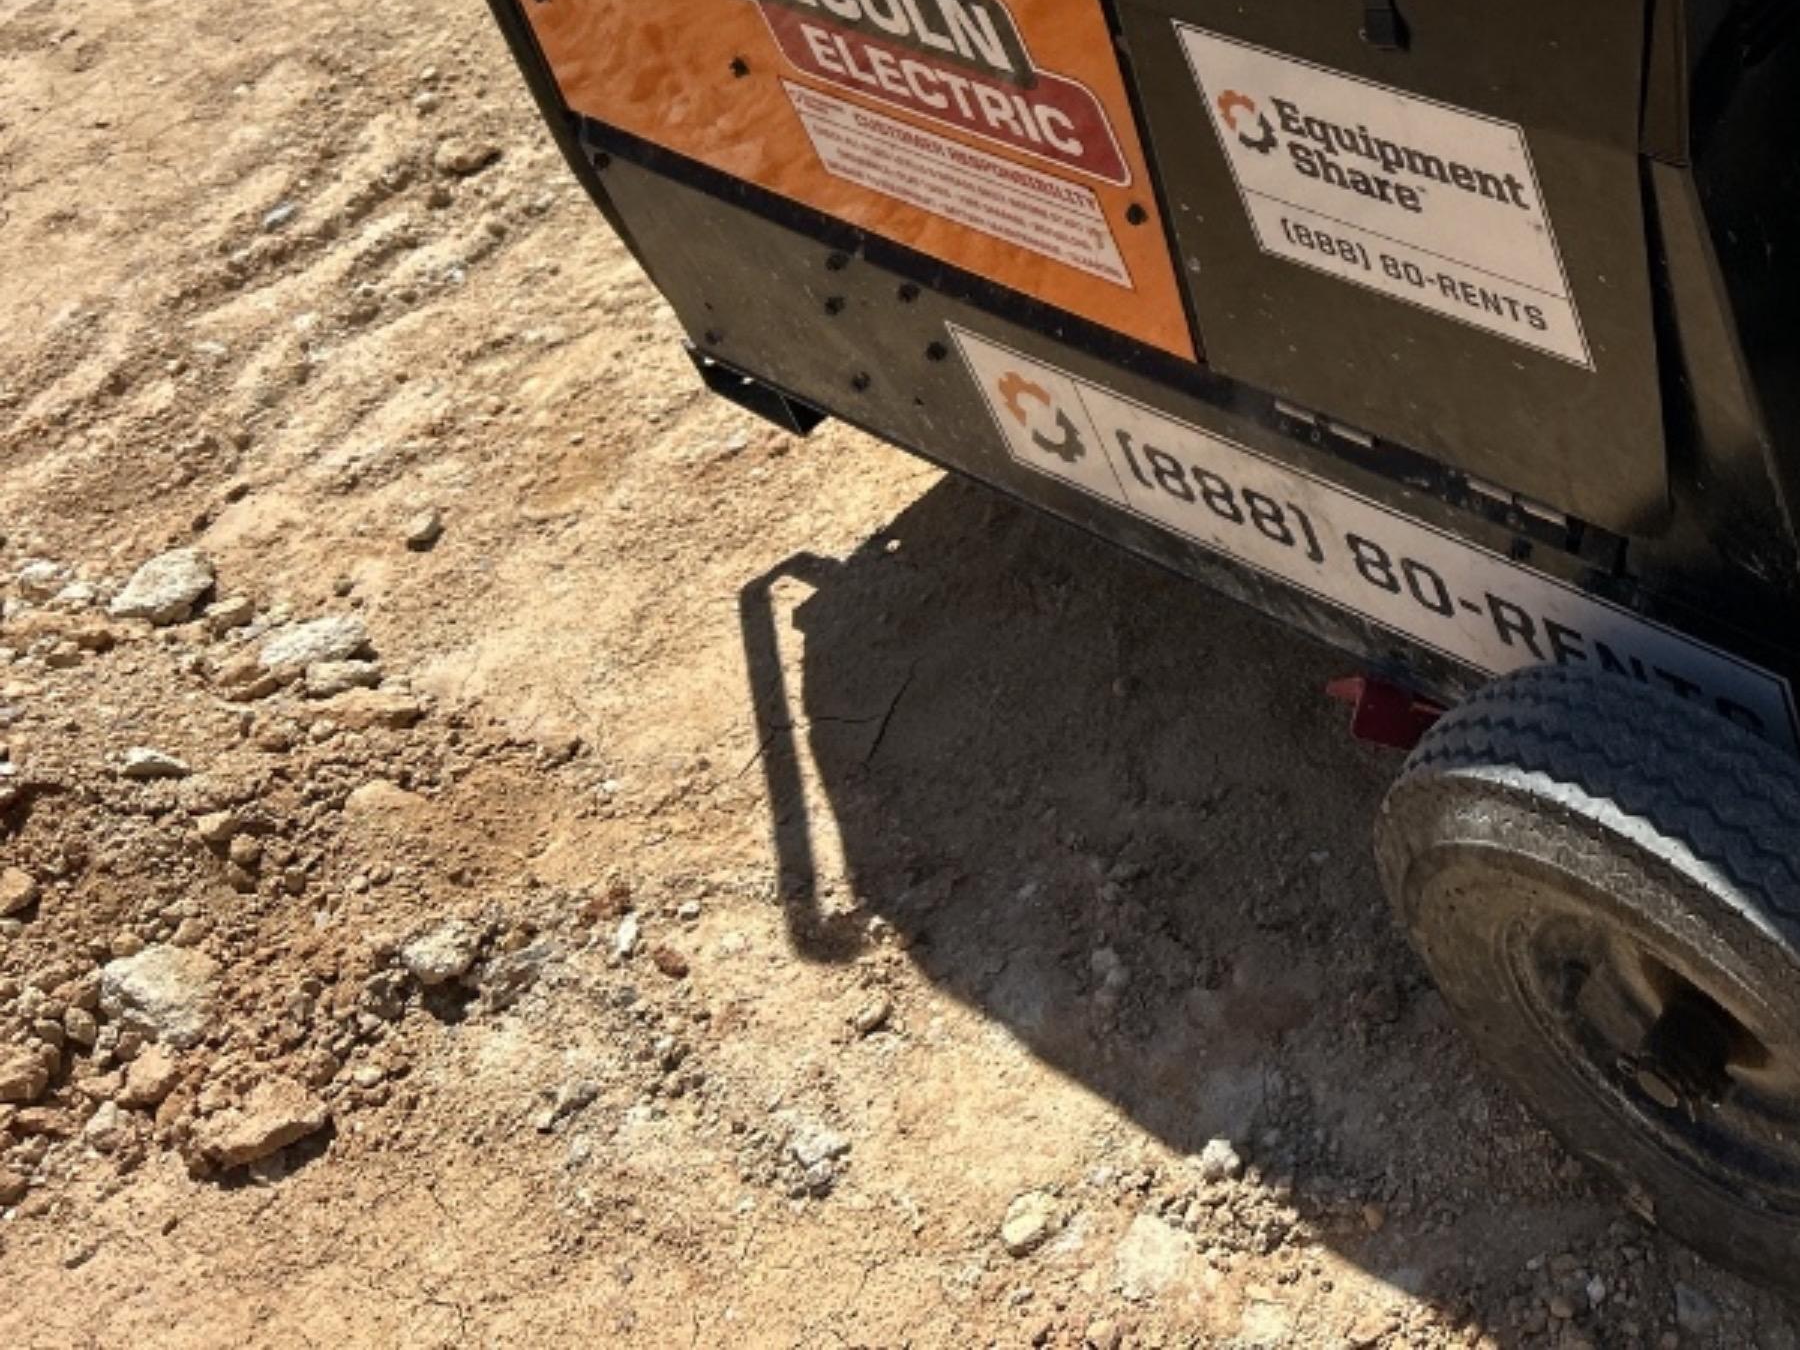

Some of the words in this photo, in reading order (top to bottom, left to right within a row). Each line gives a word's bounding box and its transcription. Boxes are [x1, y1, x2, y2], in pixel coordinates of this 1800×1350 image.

[800, 23, 1084, 157] ELECTRIC
[1269, 96, 1530, 210] Equipment
[1287, 139, 1423, 214] Share
[1280, 216, 1372, 271] (888)
[1380, 252, 1550, 331] 80-RENTS
[1115, 427, 1327, 562] (888)
